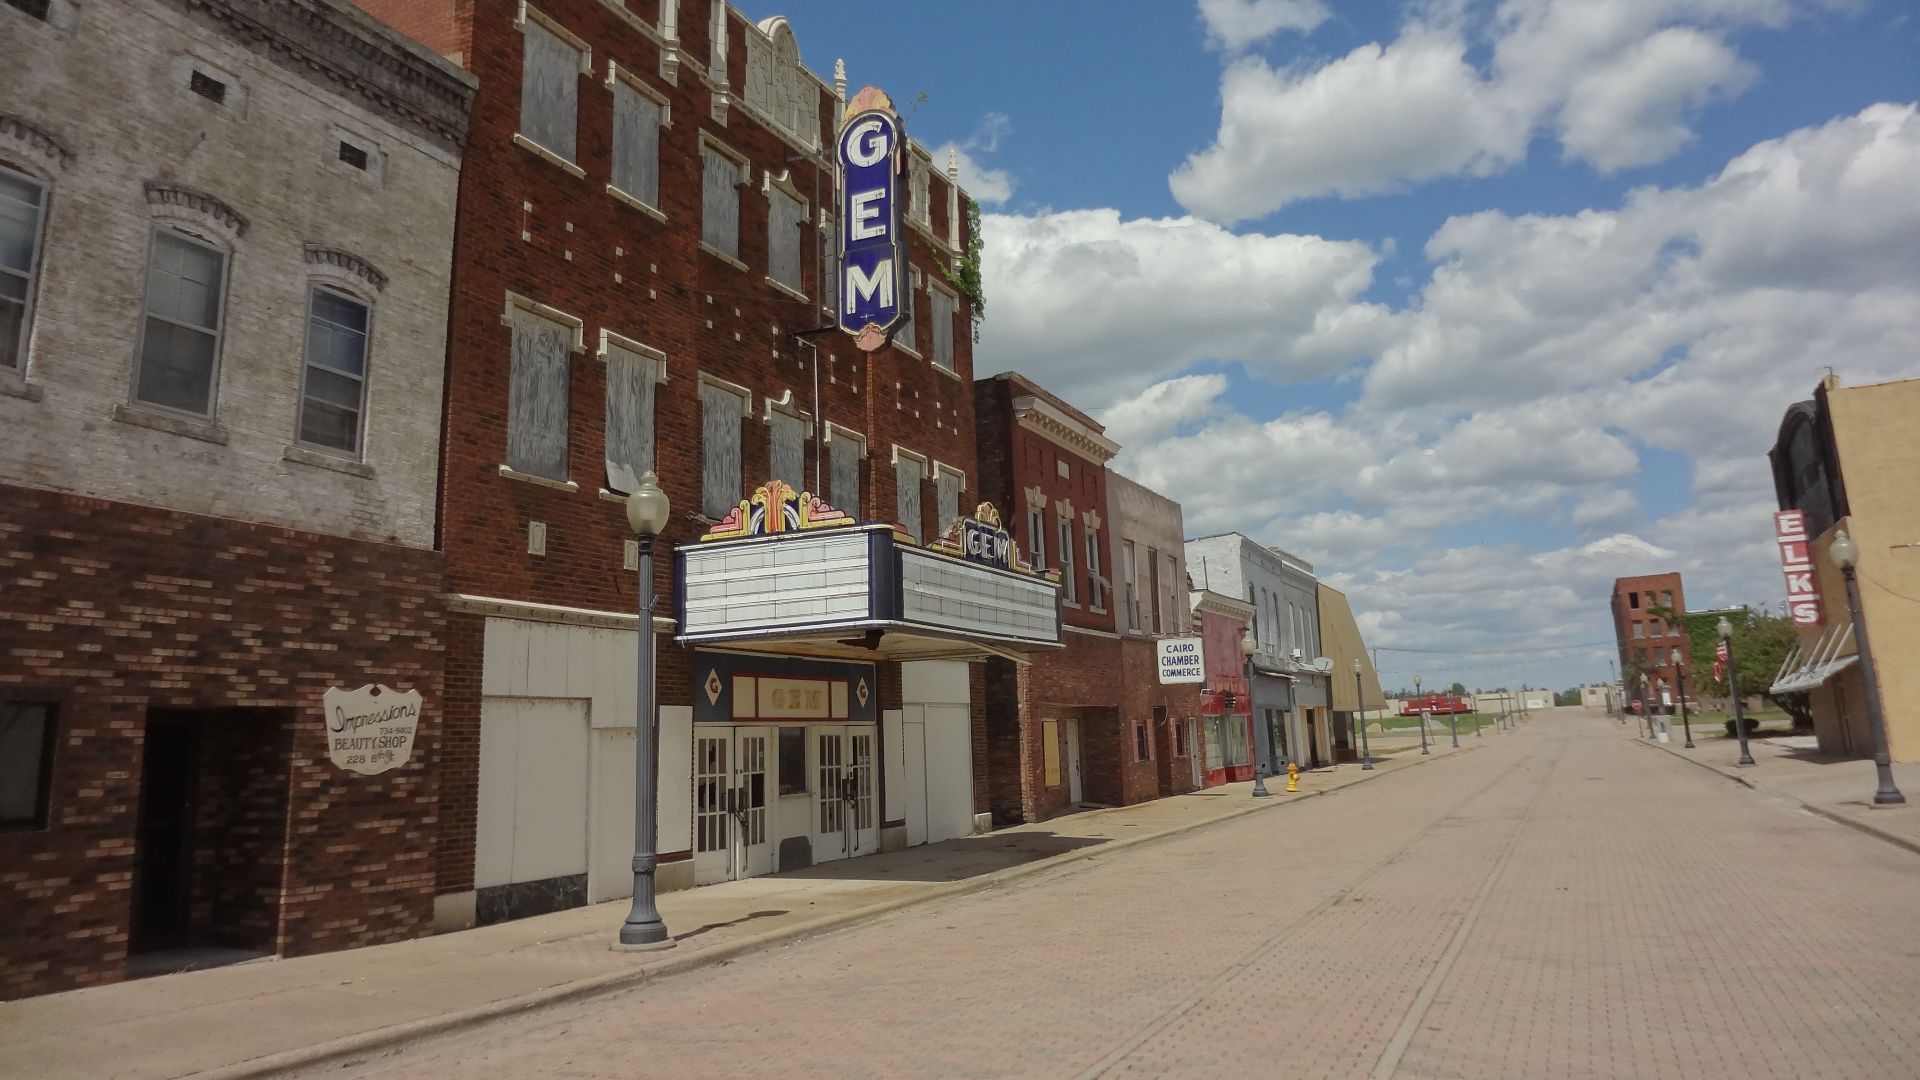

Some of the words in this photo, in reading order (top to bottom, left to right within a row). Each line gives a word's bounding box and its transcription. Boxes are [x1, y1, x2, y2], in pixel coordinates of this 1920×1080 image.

[846, 121, 893, 315] GEM
[967, 529, 1008, 563] GEM
[1778, 513, 1819, 623] ELKS
[1166, 644, 1194, 653] CAIRO
[1161, 655, 1199, 666] CHAMBER
[1162, 668, 1201, 677] COMMERCE
[709, 677, 719, 694] G
[859, 684, 867, 699] G
[330, 704, 417, 733] Impressions
[334, 737, 377, 750] BEAUTY
[378, 735, 407, 749] SHOP
[346, 755, 366, 764] 228
